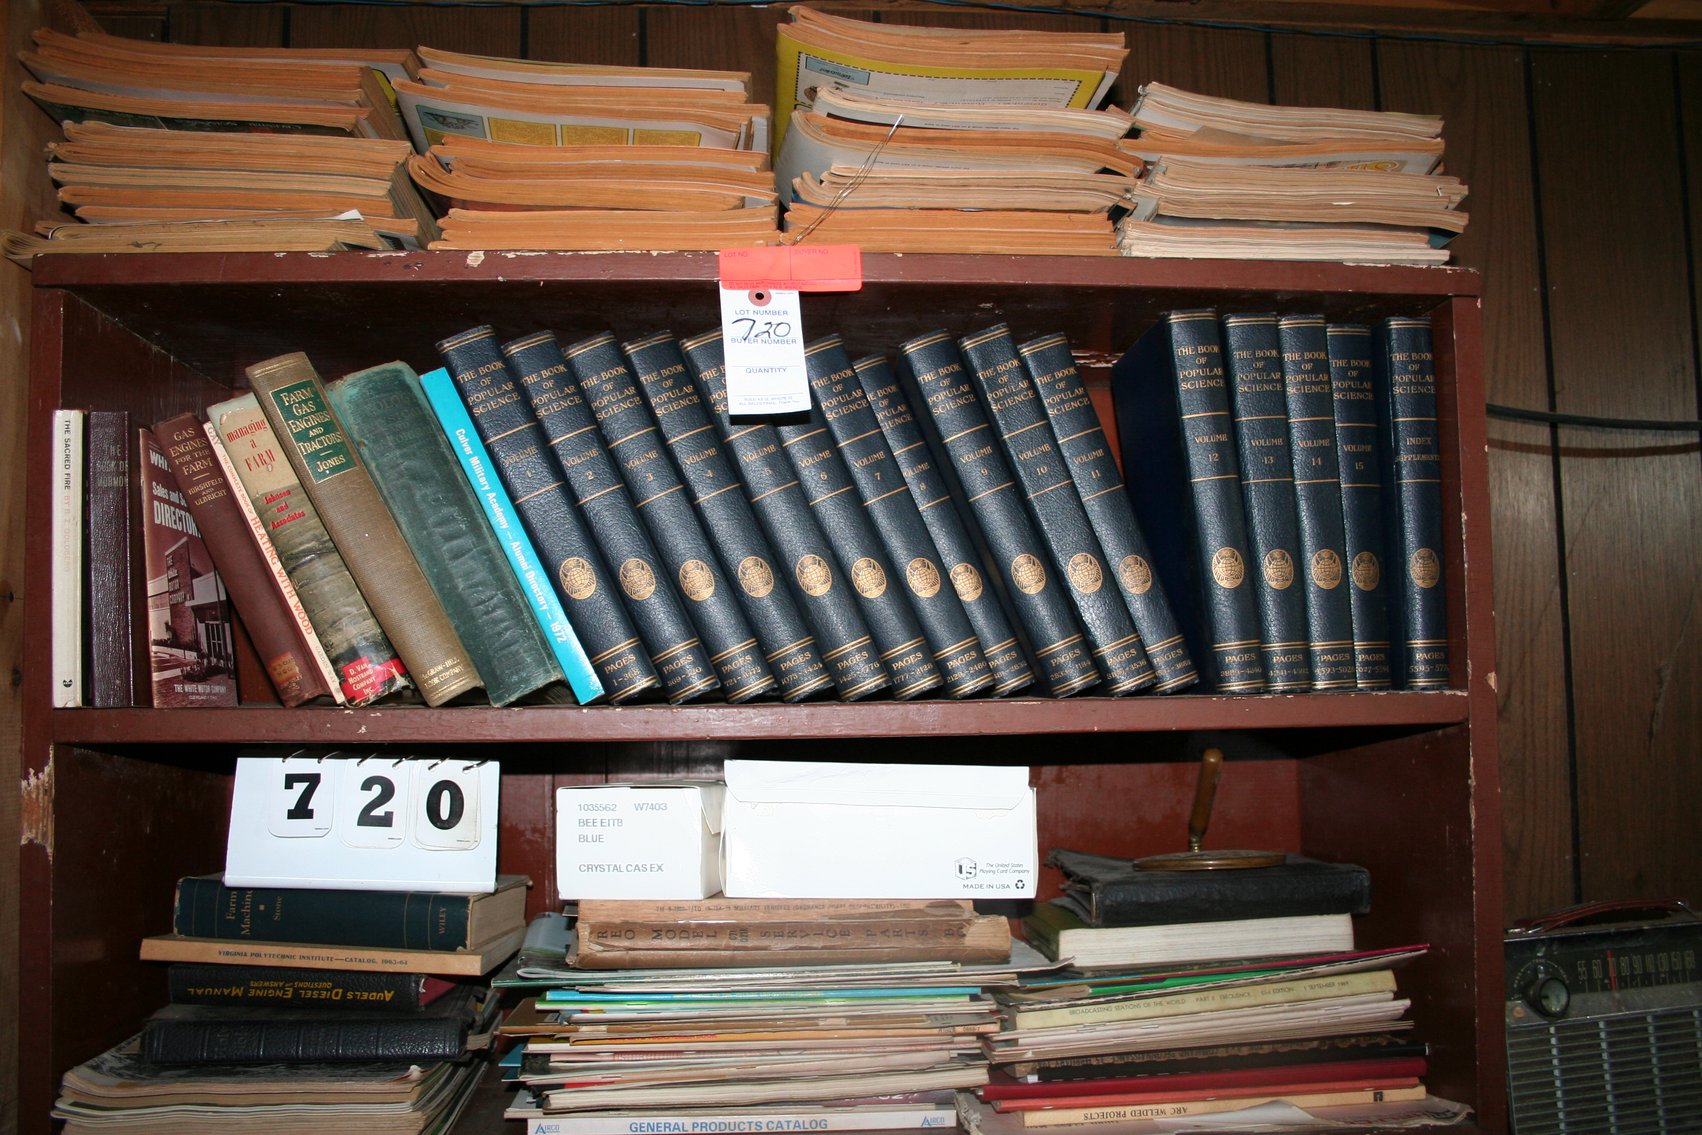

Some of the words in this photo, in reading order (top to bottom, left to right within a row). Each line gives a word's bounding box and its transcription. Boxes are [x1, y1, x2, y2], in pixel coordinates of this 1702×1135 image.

[732, 318, 792, 340] 720
[1255, 349, 1280, 358] BOOK
[478, 360, 506, 377] BOOK
[540, 364, 568, 380] BOOK
[601, 365, 628, 382] BOOK
[660, 364, 686, 378] BOOK
[938, 362, 962, 377] BOOK
[996, 359, 1022, 373] BOOK
[1054, 366, 1077, 380] BOOK
[831, 368, 854, 384] BOOK
[1181, 378, 1226, 390] SCIENCE
[1236, 372, 1282, 381] POPULAR
[1286, 374, 1329, 384] POPULAR
[280, 386, 314, 406] FARM
[468, 382, 516, 406] POPULAR
[650, 384, 694, 408] POPULAR
[876, 384, 898, 398] BOOK
[928, 384, 970, 406] POPULAR
[987, 379, 1030, 401] POPULAR
[1045, 386, 1085, 406] POPULAR
[1238, 382, 1283, 393] SCIENCE
[1286, 384, 1330, 394] SCIENCE
[1392, 386, 1436, 394] SCIENCE
[472, 392, 522, 416] SCIENCE
[530, 386, 576, 408] POPULAR
[591, 386, 636, 412] POPULAR
[821, 388, 864, 410] POPULAR
[932, 394, 976, 416] SCIENCE
[991, 390, 1036, 411] SCIENCE
[292, 400, 317, 416] GAS
[536, 395, 582, 420] SCIENCE
[596, 396, 642, 421] SCIENCE
[654, 394, 700, 418] SCIENCE
[826, 400, 868, 421] SCIENCE
[1049, 398, 1090, 418] SCIENCE
[226, 418, 268, 443] managing
[288, 410, 330, 434] ENGINES
[174, 428, 195, 442] GAS
[309, 426, 324, 438] AND
[1194, 434, 1228, 444] VOLUME
[169, 438, 209, 458] ENGINES
[297, 431, 344, 456] TRACTORS
[1250, 438, 1284, 446] VOLUME
[1298, 438, 1330, 448] VOLUME
[64, 438, 72, 470] SACRED
[175, 454, 192, 465] FOR
[192, 450, 210, 458] THE
[245, 448, 276, 472] FARM
[564, 448, 600, 468] VOLUME
[624, 450, 658, 470] VOLUME
[684, 447, 718, 465] VOLUME
[798, 450, 832, 468] VOLUME
[854, 450, 886, 468] VOLUME
[960, 446, 992, 464] VOLUME
[1018, 444, 1050, 461] VOLUME
[1074, 447, 1104, 466] VOLUME
[182, 457, 214, 476] FARM
[316, 454, 346, 473] JONES
[276, 502, 288, 513] and
[271, 511, 306, 530] Associates
[456, 428, 472, 455] Culver
[470, 456, 492, 492] Military
[486, 492, 510, 530] Academy
[510, 541, 530, 571] Alumni
[524, 570, 549, 612] Directory
[550, 620, 568, 643] 1972
[250, 514, 276, 566] HEATING
[276, 568, 296, 598] WITH
[293, 600, 313, 636] WOOD
[604, 654, 636, 674] PAGES
[662, 654, 694, 674] PAGES
[722, 655, 752, 674] PAGES
[780, 651, 812, 670] PAGES
[837, 651, 868, 670] PAGES
[892, 652, 922, 670] PAGES
[946, 651, 977, 669] PAGES
[989, 651, 1017, 668] PAGES
[1050, 649, 1081, 667] PAGES
[1106, 649, 1136, 665] PAGES
[1153, 648, 1183, 665] PAGES
[1225, 652, 1256, 664] PAGES
[1272, 654, 1302, 664] PAGES
[1320, 654, 1350, 662] PAGES
[352, 676, 376, 691] COMPANY
[578, 803, 617, 812] 1035562
[633, 802, 668, 812] W7403
[578, 818, 598, 828] BEE
[578, 834, 605, 843] BLUE
[578, 864, 624, 872] CRYSTAL
[226, 891, 238, 920] Farm
[272, 896, 282, 920] Stone
[438, 906, 447, 934] WILEY
[597, 929, 636, 940] REO
[652, 929, 717, 940] MODEL
[760, 929, 850, 940] SERVICE
[865, 928, 928, 938] PARTS
[218, 950, 248, 958] VIRGINIA
[250, 952, 296, 960] POLYTECHNIC
[187, 986, 244, 998] MANUAL
[250, 980, 284, 988] ANSWERS
[294, 982, 333, 990] QUESTIONS
[248, 988, 293, 999] ENGINE
[299, 988, 343, 1000] DIESEL
[346, 990, 394, 1002] AUDELS
[1082, 1110, 1127, 1120] PROJECTS
[1130, 1108, 1167, 1118] WELDED
[1170, 1106, 1188, 1116] ARC
[630, 1122, 688, 1132] GENERAL
[692, 1120, 763, 1132] PRODUCTS
[766, 1118, 828, 1130] CATALOG
